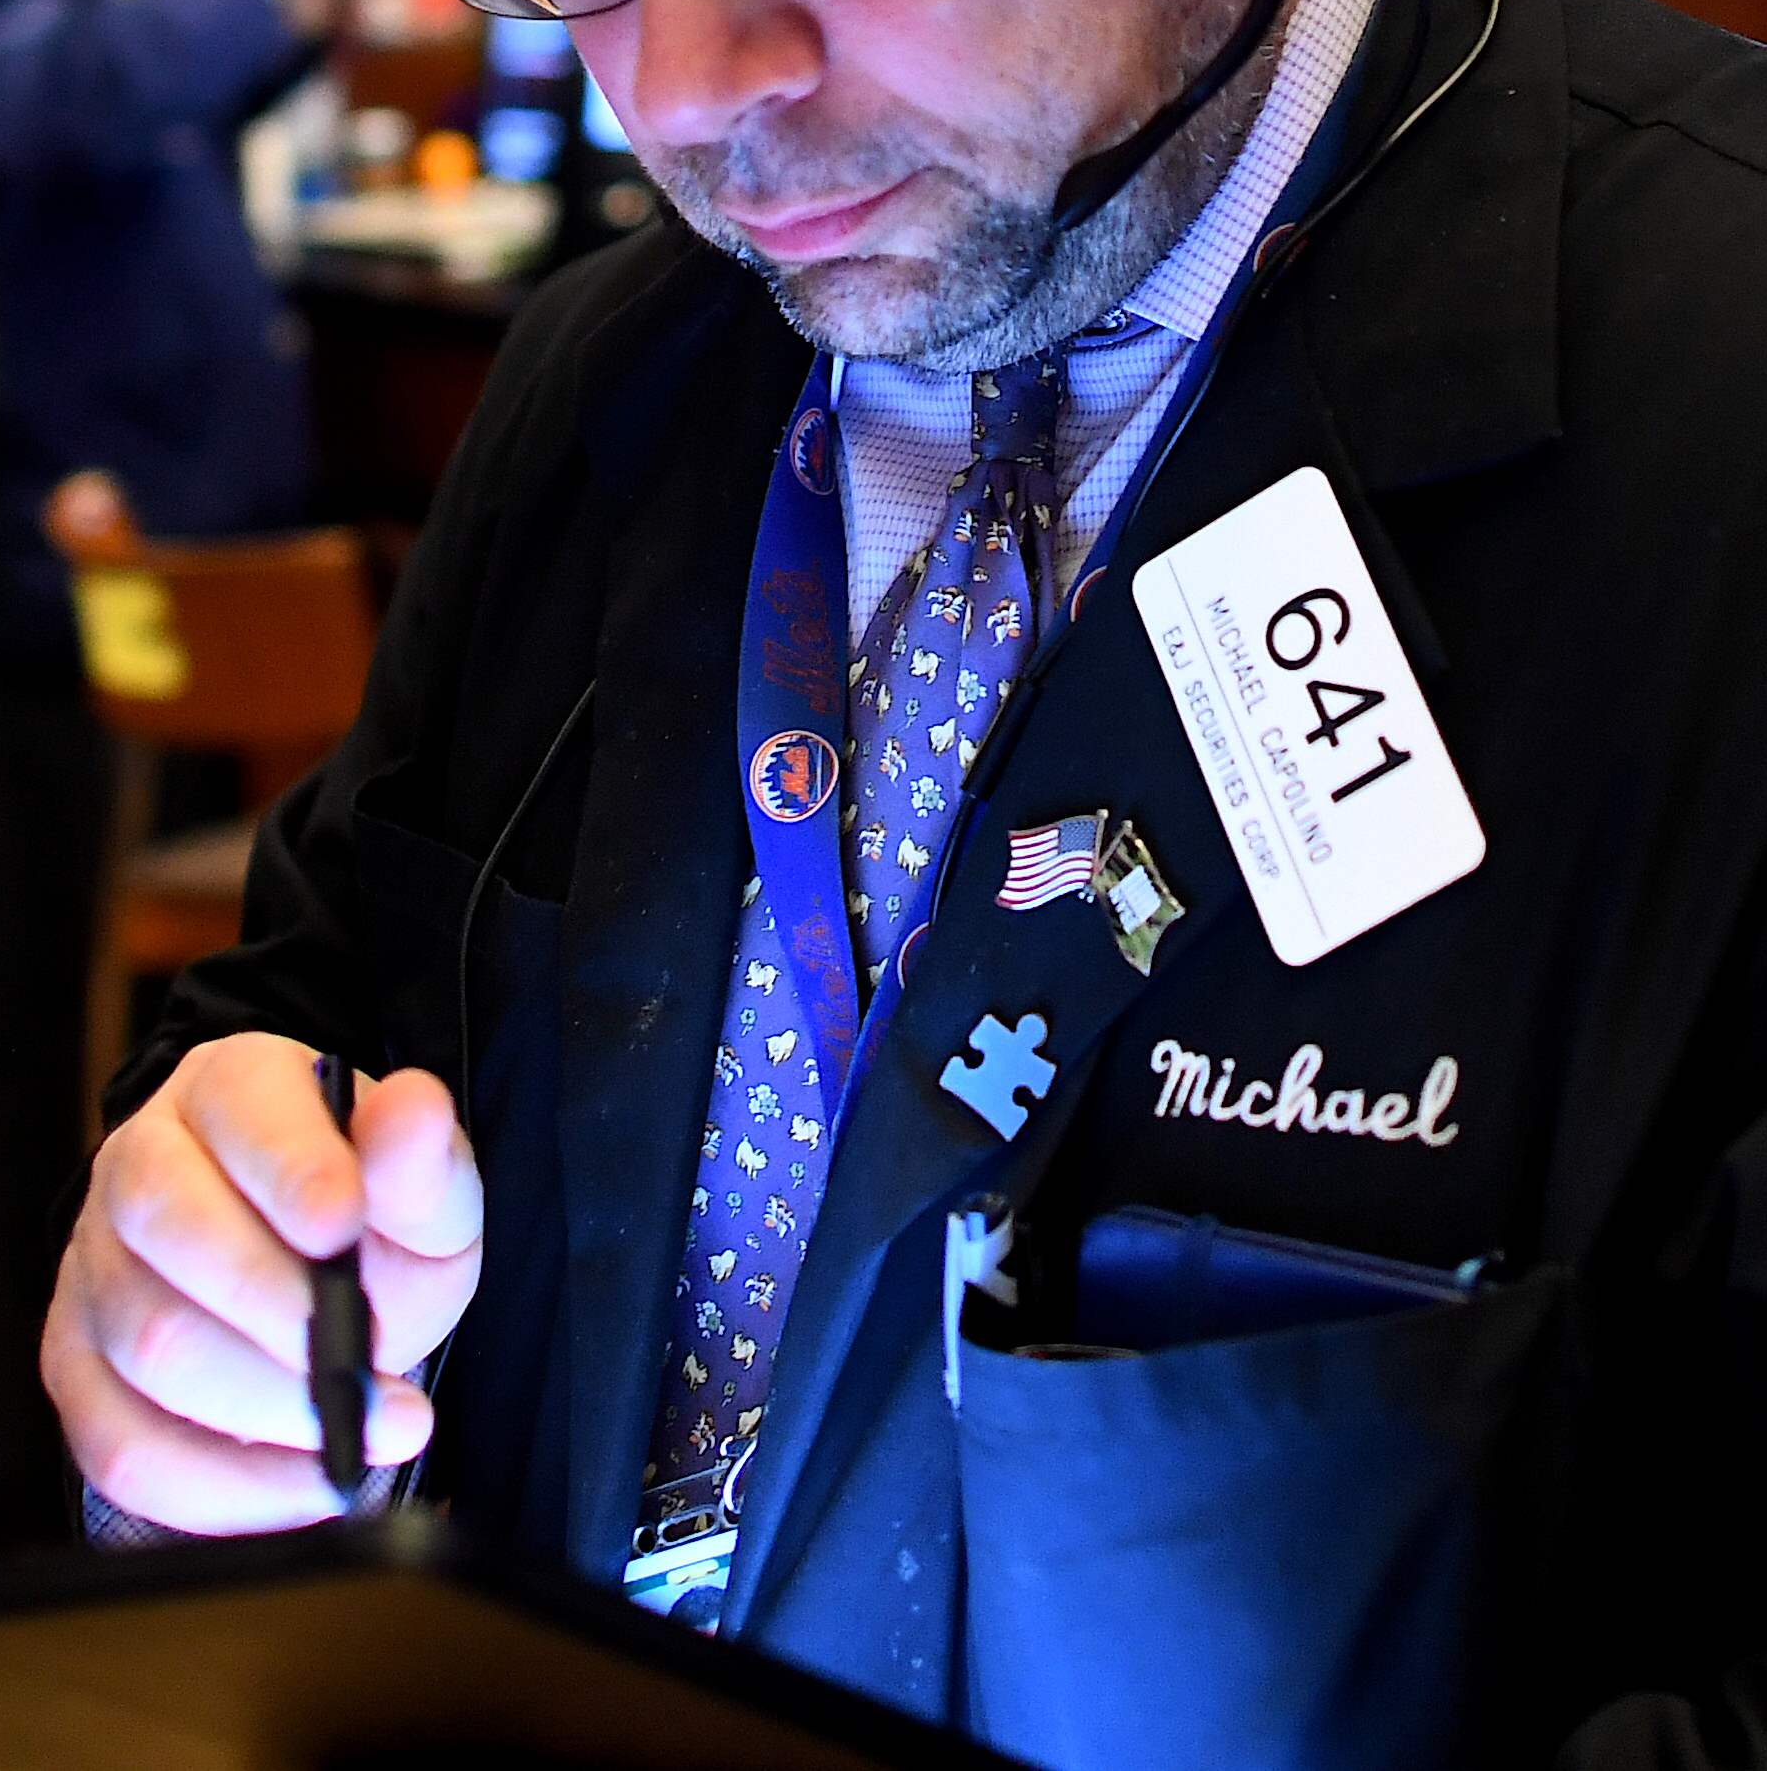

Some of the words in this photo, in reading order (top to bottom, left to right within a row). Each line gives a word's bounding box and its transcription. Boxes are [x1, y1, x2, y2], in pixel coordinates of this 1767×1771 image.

[1161, 625, 1191, 671] E&J
[1184, 678, 1249, 809] SECURITIES
[1205, 595, 1267, 717] MICHAEL
[1259, 726, 1333, 865] CAPOLINO
[1265, 587, 1413, 804] 641
[1150, 1038, 1460, 1148] Michael
